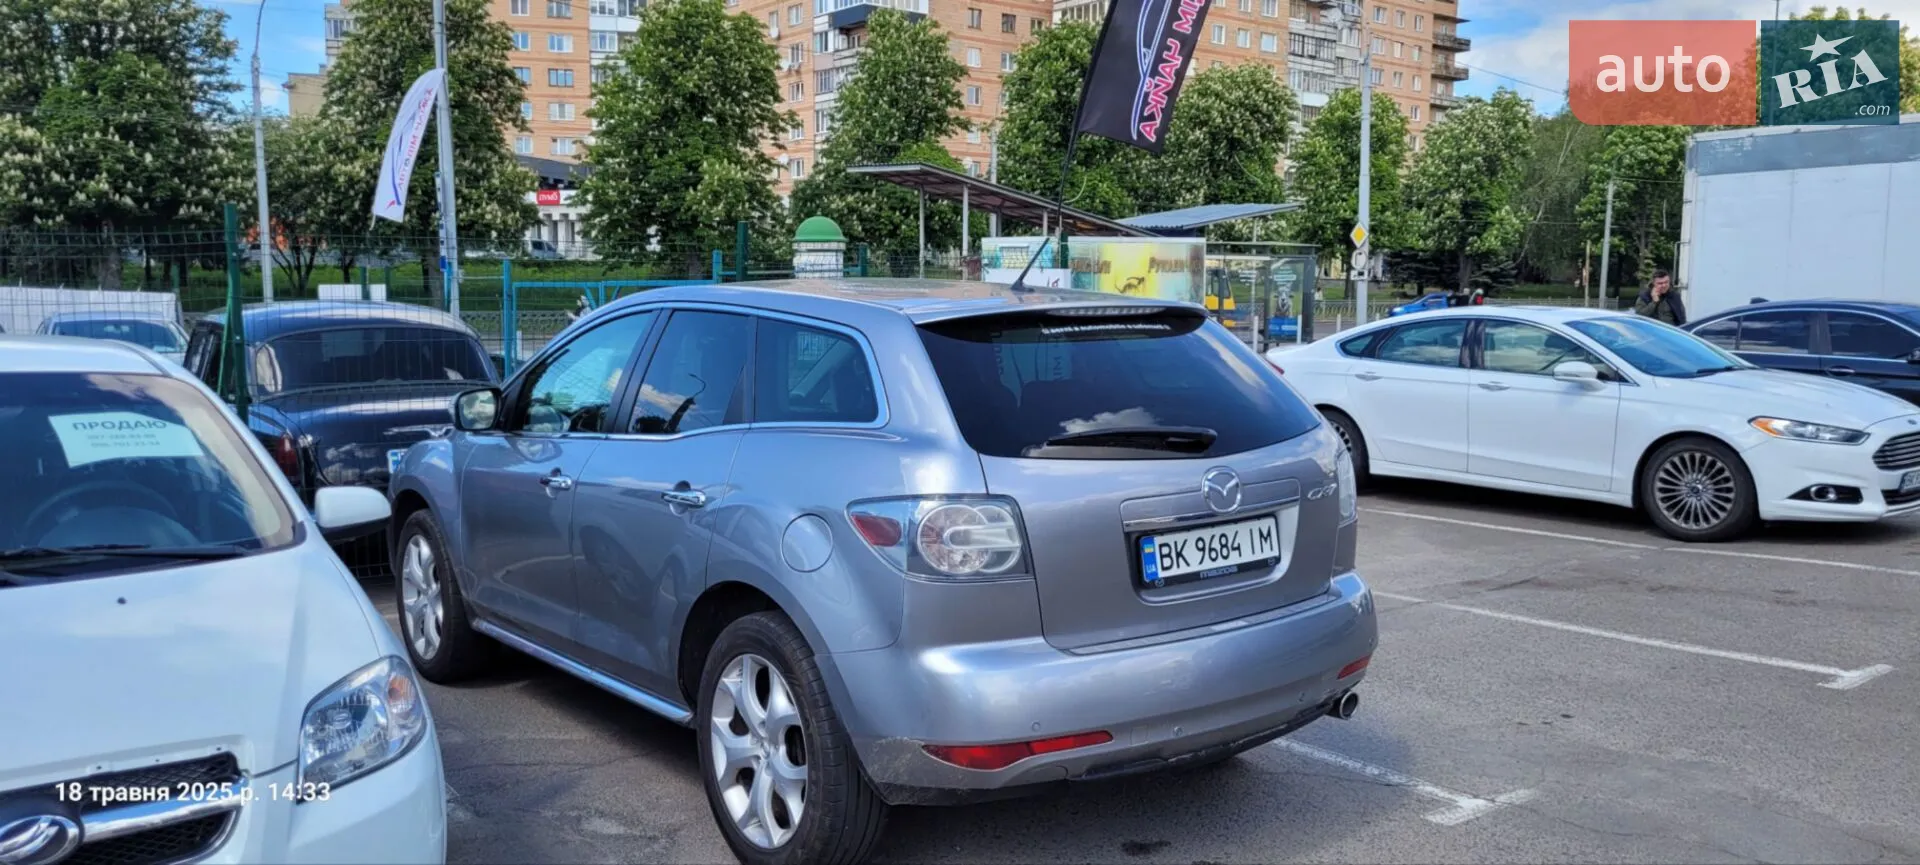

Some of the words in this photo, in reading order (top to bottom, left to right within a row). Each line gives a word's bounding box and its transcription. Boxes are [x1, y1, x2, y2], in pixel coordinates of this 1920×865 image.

[72, 420, 168, 431] ПРОДАЮ
[1159, 538, 1190, 571] BK
[1195, 530, 1242, 565] 9684
[1249, 525, 1274, 555] IM
